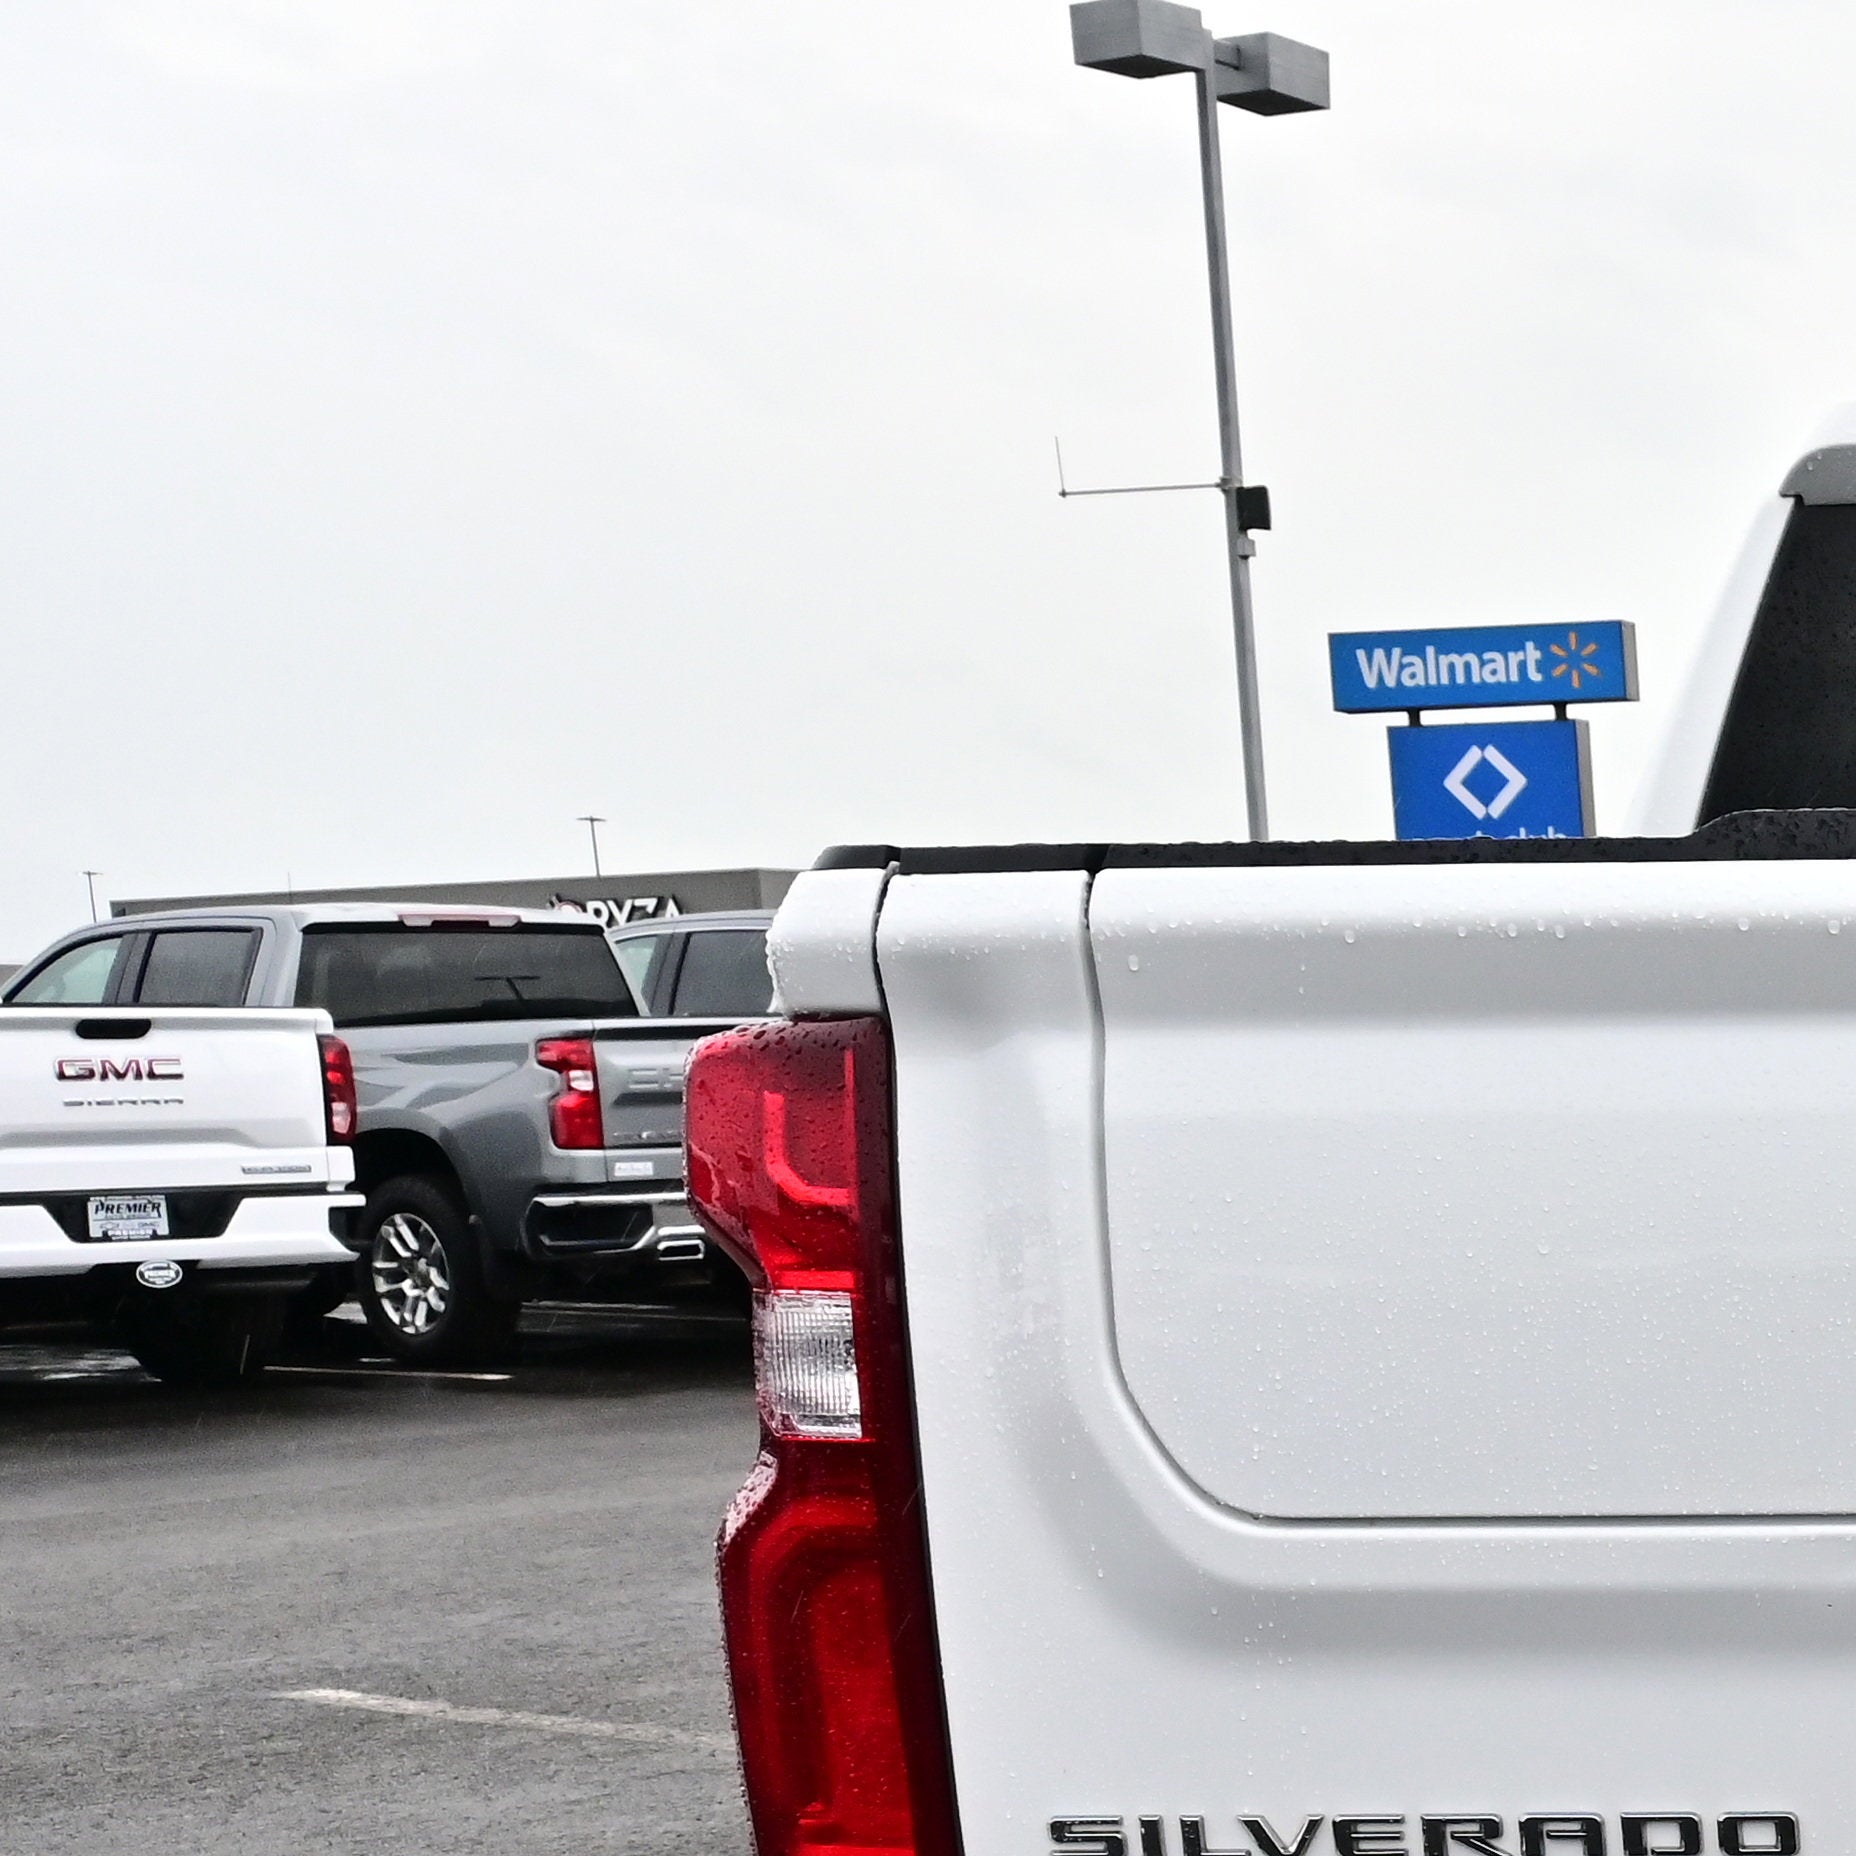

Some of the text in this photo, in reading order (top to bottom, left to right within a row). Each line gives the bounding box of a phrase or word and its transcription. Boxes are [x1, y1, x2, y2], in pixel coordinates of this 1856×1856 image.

[1356, 641, 1543, 689] Walmart
[57, 1058, 184, 1081] GMC
[95, 1200, 162, 1218] PREMIER
